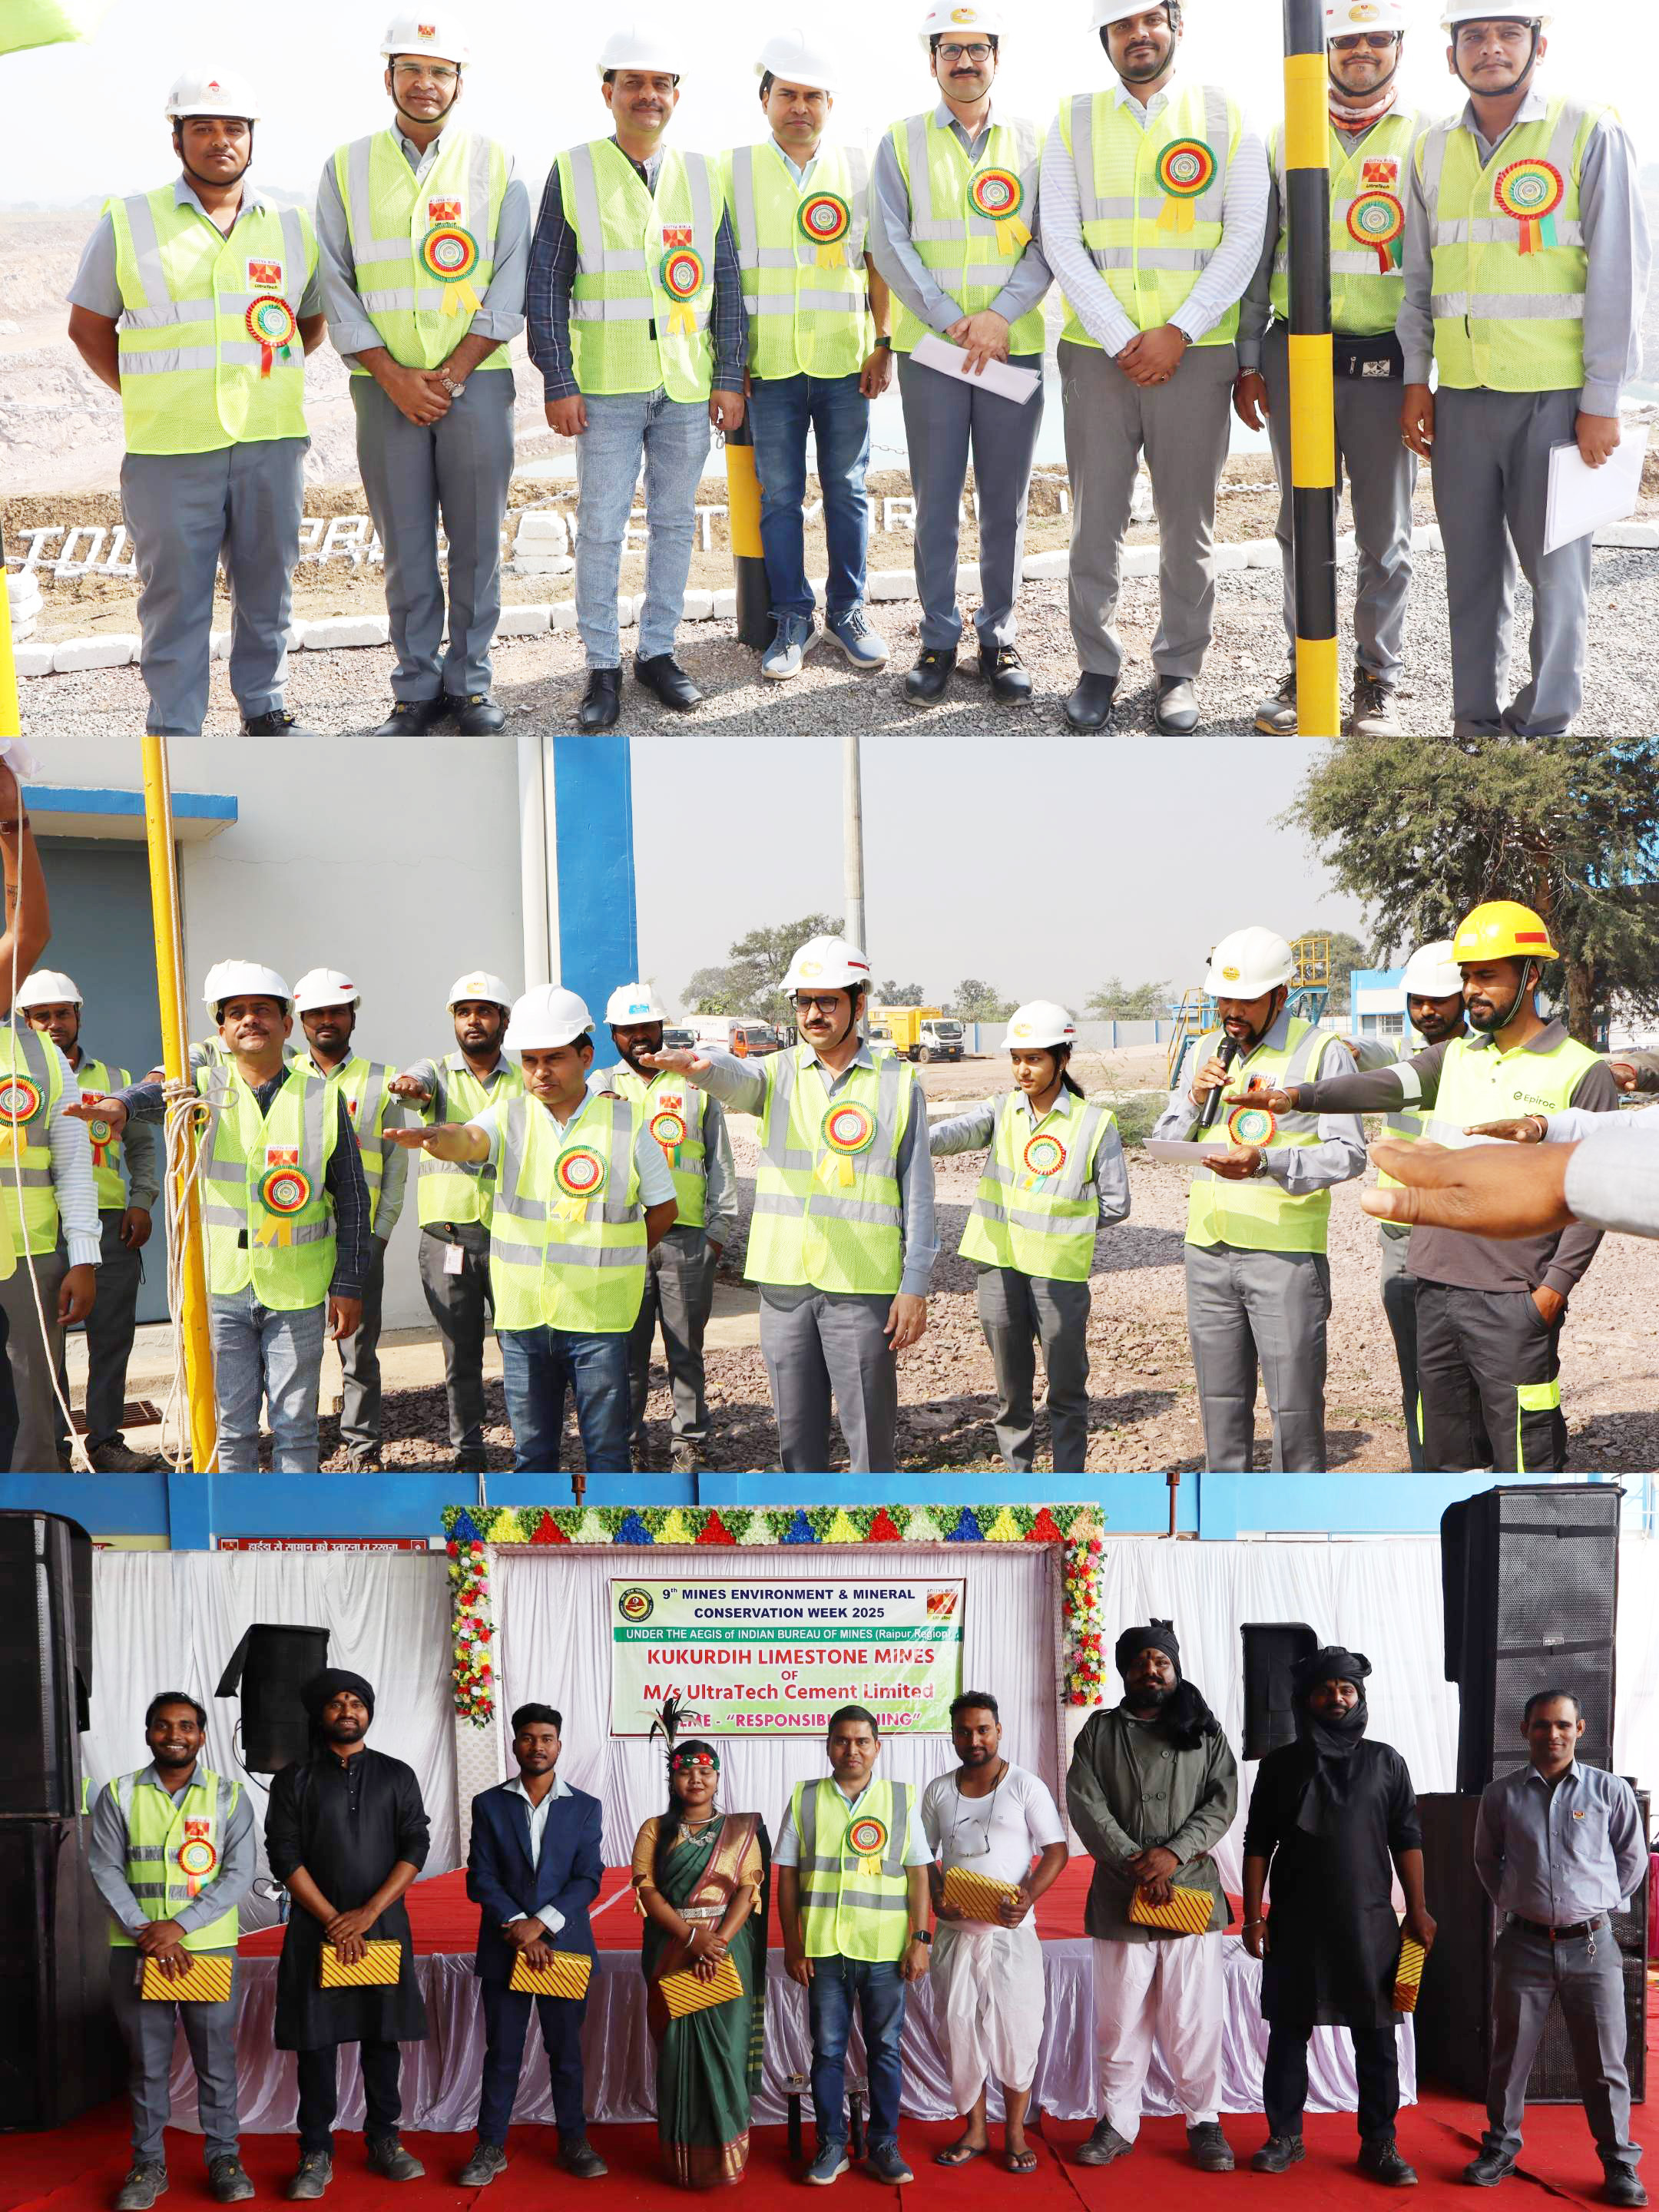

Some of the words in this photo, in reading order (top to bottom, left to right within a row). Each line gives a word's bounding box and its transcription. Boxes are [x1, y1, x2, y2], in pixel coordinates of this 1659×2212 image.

[1524, 1094, 1555, 1108] Epiroc
[663, 1588, 677, 1600] 9th
[682, 1589, 727, 1600] MINES
[730, 1589, 833, 1600] ENVIRONMENT
[839, 1589, 848, 1600] &
[853, 1589, 916, 1599] MINERAL
[694, 1608, 803, 1618] CONSERVATION
[808, 1608, 848, 1618] WEEK
[852, 1608, 885, 1618] 2025
[626, 1629, 664, 1639] UNDER
[666, 1629, 687, 1639] THE
[690, 1629, 723, 1639] AEGIS
[724, 1629, 735, 1639] of
[738, 1629, 774, 1639] INDIAN
[777, 1629, 821, 1639] BUREAU
[823, 1629, 837, 1639] OF
[840, 1629, 873, 1639] MINES
[875, 1629, 912, 1641] (Raipur
[647, 1649, 751, 1664] KUKURDIH
[758, 1649, 868, 1664] LIMESTONE
[874, 1648, 935, 1664] MINES
[781, 1671, 799, 1681] OF
[644, 1684, 681, 1701] M/s
[687, 1684, 778, 1700] UltraTech
[784, 1684, 857, 1699] Cement
[864, 1683, 934, 1699] Limited
[727, 1714, 831, 1727] “RESPONSIB
